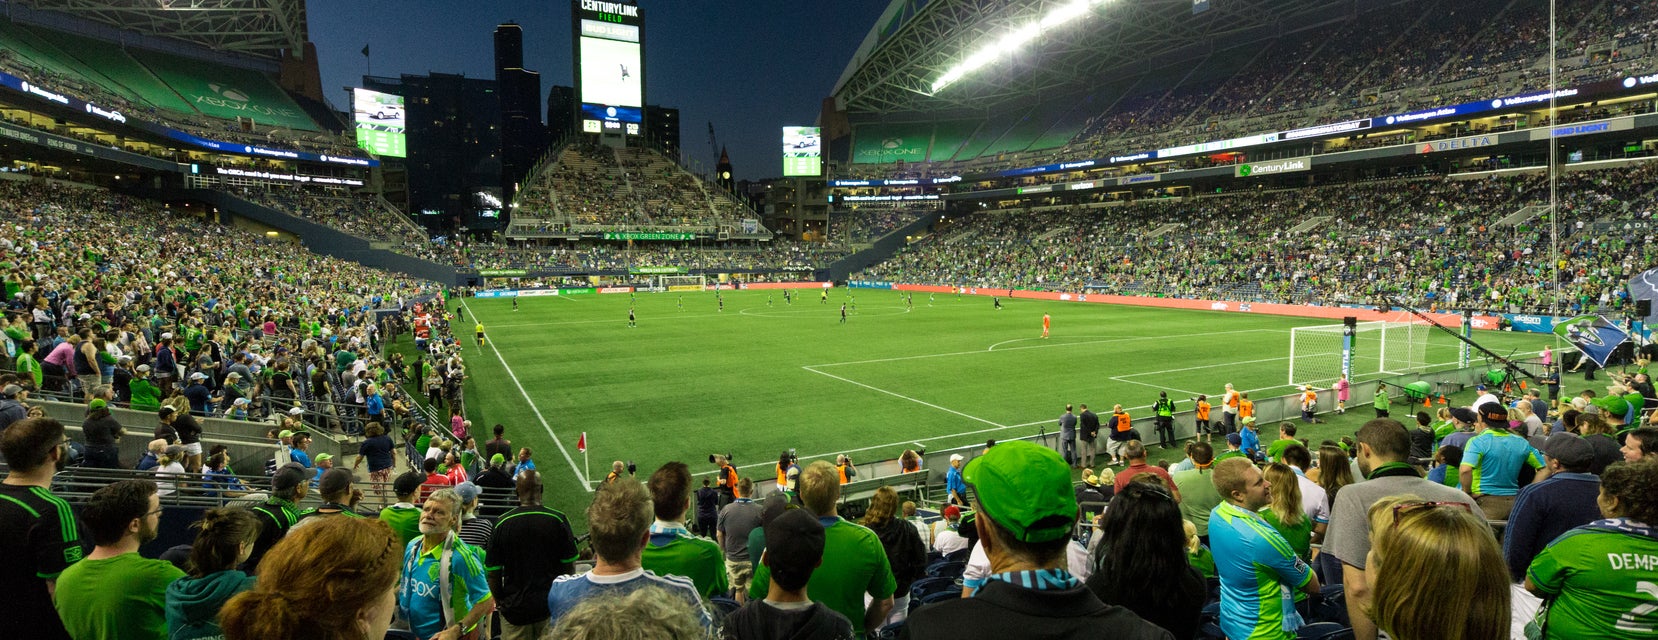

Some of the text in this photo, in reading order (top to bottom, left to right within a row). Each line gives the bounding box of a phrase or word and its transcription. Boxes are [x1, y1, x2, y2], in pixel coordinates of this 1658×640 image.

[581, 0, 638, 17] CENTURYLINK
[598, 12, 622, 22] FIELD
[586, 24, 635, 36] BUD LIGHT
[190, 94, 256, 112] XBOX
[1504, 88, 1578, 106] Volkswagen Atlas
[1396, 108, 1456, 123] Volkswagen Atlas
[1552, 122, 1608, 137] BUD LIGHT
[1438, 136, 1492, 151] DELTA
[1252, 160, 1304, 174] CenturyLink
[1071, 182, 1093, 190] verizon
[1514, 315, 1541, 324] slalom
